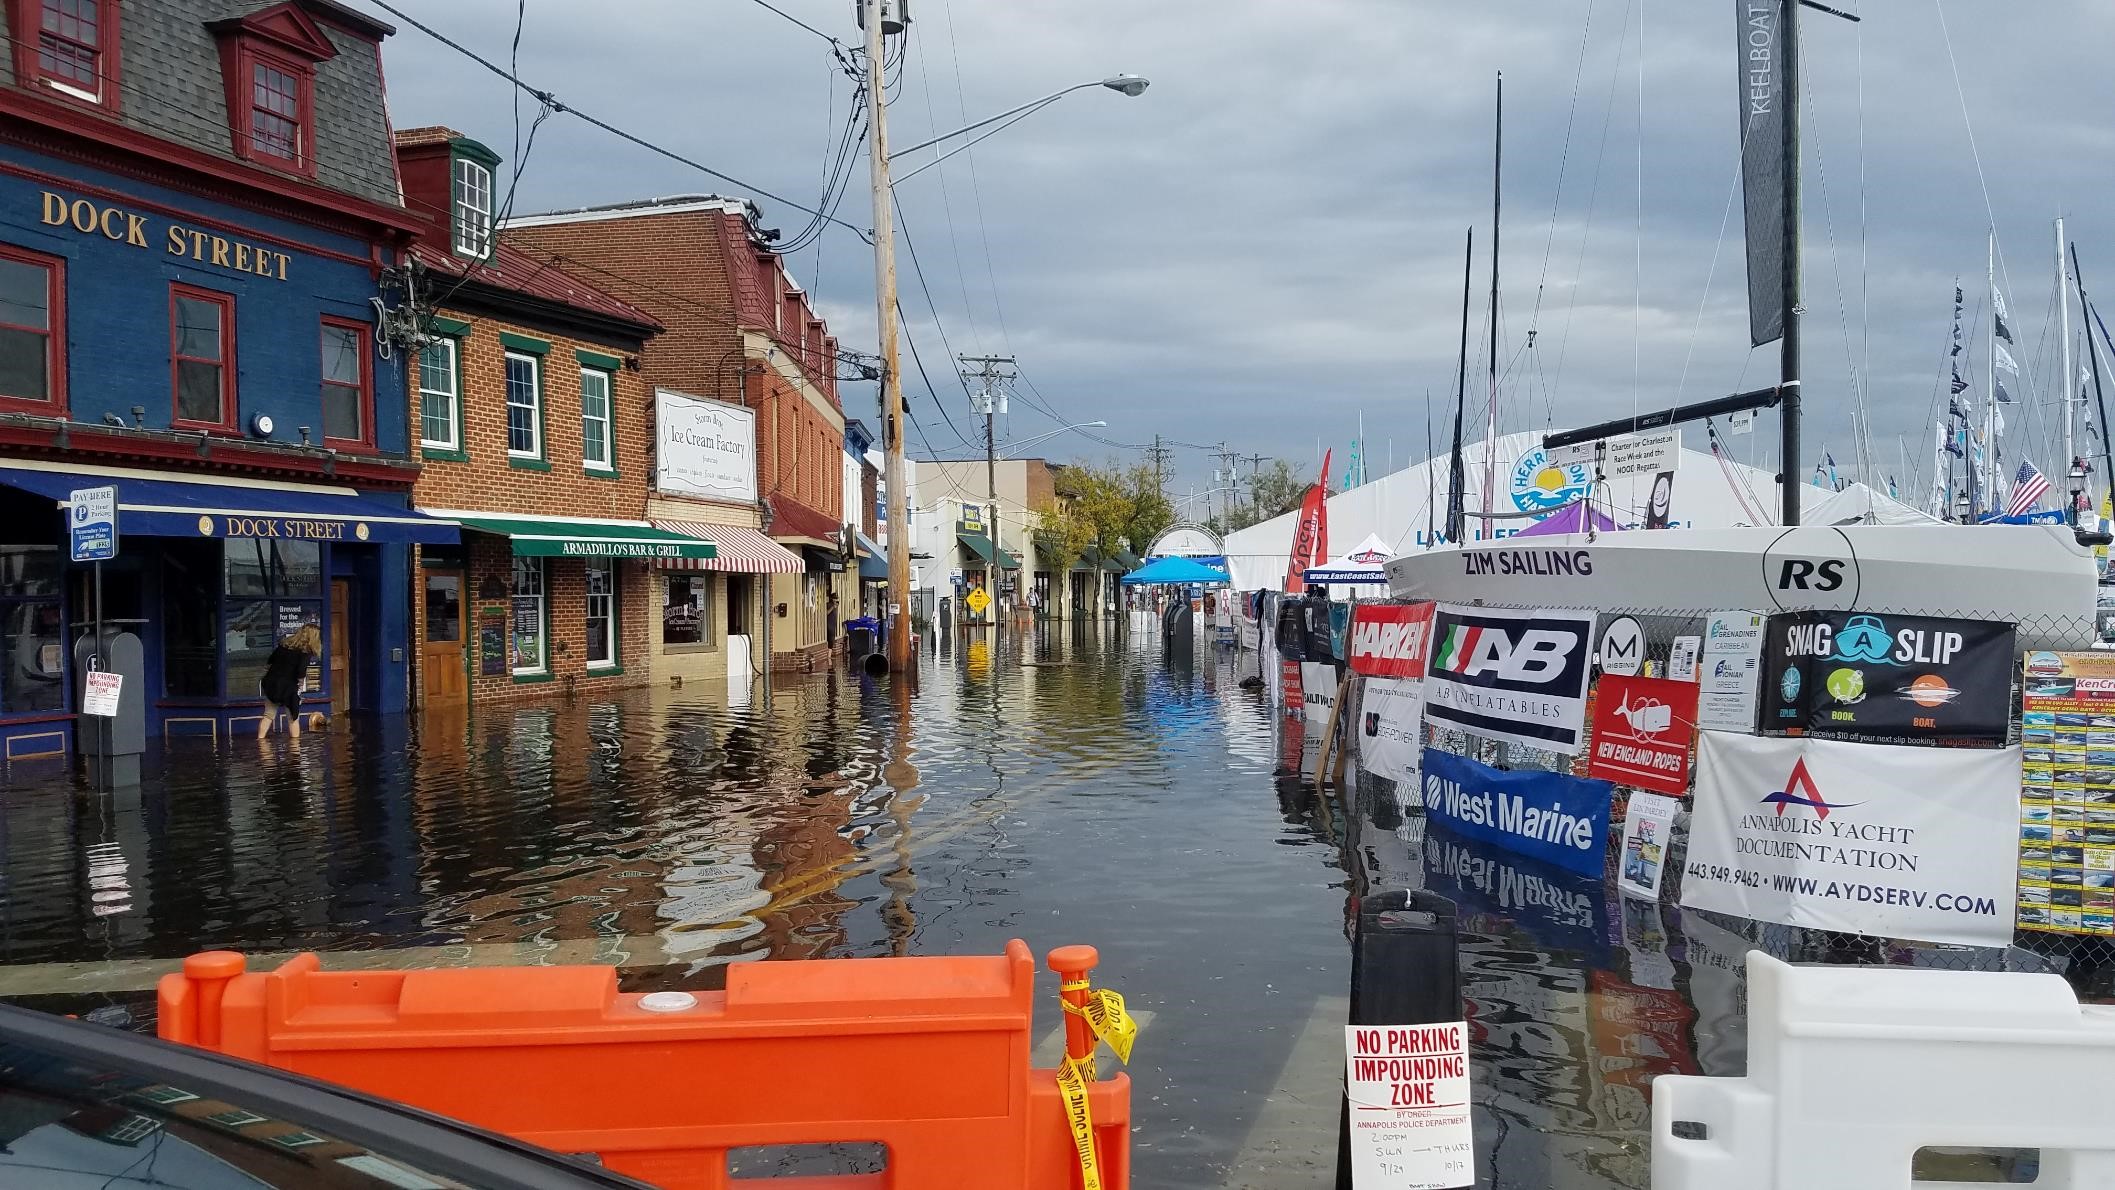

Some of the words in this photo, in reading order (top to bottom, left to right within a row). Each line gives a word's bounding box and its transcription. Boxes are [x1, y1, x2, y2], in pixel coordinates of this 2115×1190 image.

[1748, 3, 1771, 115] KEELBOAT
[40, 191, 149, 248] DOCK
[167, 224, 292, 281] STREET
[671, 425, 684, 444] Ice
[686, 428, 714, 450] Cream
[716, 434, 745, 460] Factory
[1611, 440, 1632, 452] Charter
[1641, 436, 1673, 447] Charleston
[1613, 453, 1626, 463] Race
[1643, 451, 1654, 460] and
[1655, 449, 1665, 458] the
[74, 494, 88, 502] PAY
[90, 490, 112, 501] HERE
[226, 518, 281, 537] DOCK
[284, 520, 346, 539] STREET
[563, 542, 628, 556] ARMADILLO'S
[629, 544, 646, 556] BAR
[647, 545, 655, 556] &
[656, 545, 683, 557] GRILL
[1462, 552, 1496, 575] ZIM
[1499, 550, 1593, 576] SAILING
[1309, 571, 1387, 581] www.EastCoastSail
[1777, 558, 1846, 592] RS
[279, 605, 301, 613] Brewed
[1222, 589, 1230, 617] ATM
[1718, 630, 1757, 638] GRENADINES
[1785, 623, 1832, 657] SNAG
[1854, 631, 1873, 650] A
[1895, 628, 1963, 665] SLIP
[1607, 633, 1637, 659] M
[1714, 642, 1750, 650] CARIBBEAN
[97, 673, 120, 682] PARKING
[1716, 681, 1740, 689] GREECE
[2076, 679, 2115, 689] KenCr
[1435, 686, 1450, 699] AB
[1455, 690, 1561, 719] INFLATABLES
[1831, 710, 1857, 722] BOOK.
[1913, 717, 1936, 729] BOAT.
[1811, 730, 1836, 738] receive
[1837, 731, 1849, 740] $10
[1849, 732, 1859, 740] off
[1859, 734, 1875, 743] your
[1876, 735, 1892, 743] next
[1893, 735, 1906, 744] slip
[1907, 737, 1937, 747] booking.
[1597, 741, 1616, 759] NEW
[1613, 744, 1654, 767] ENGLAND
[1652, 751, 1682, 772] ROPES
[1443, 778, 1495, 828] West
[1498, 792, 1593, 850] Marine
[1739, 815, 1823, 836] ANNAPOLIS
[1829, 820, 1915, 846] YACHT
[1736, 837, 1919, 872] DOCUMENTATION
[1687, 862, 1760, 889] 443.949.9462
[1772, 874, 1997, 916] WWW.AYDSERV.COM
[1356, 1029, 1382, 1054] NO
[1387, 1026, 1460, 1054] PARKING
[1354, 1056, 1464, 1082] IMPOUNDING
[1390, 1082, 1436, 1106] ZONE
[1357, 1121, 1398, 1130] ANNAPOLIS
[1399, 1119, 1424, 1129] POLICE
[1425, 1116, 1468, 1128] DEPARTMENT
[1396, 1111, 1406, 1119] BY
[1407, 1110, 1432, 1118] ORDER
[1375, 1146, 1403, 1157] SUN
[1433, 1143, 1470, 1154] THURS
